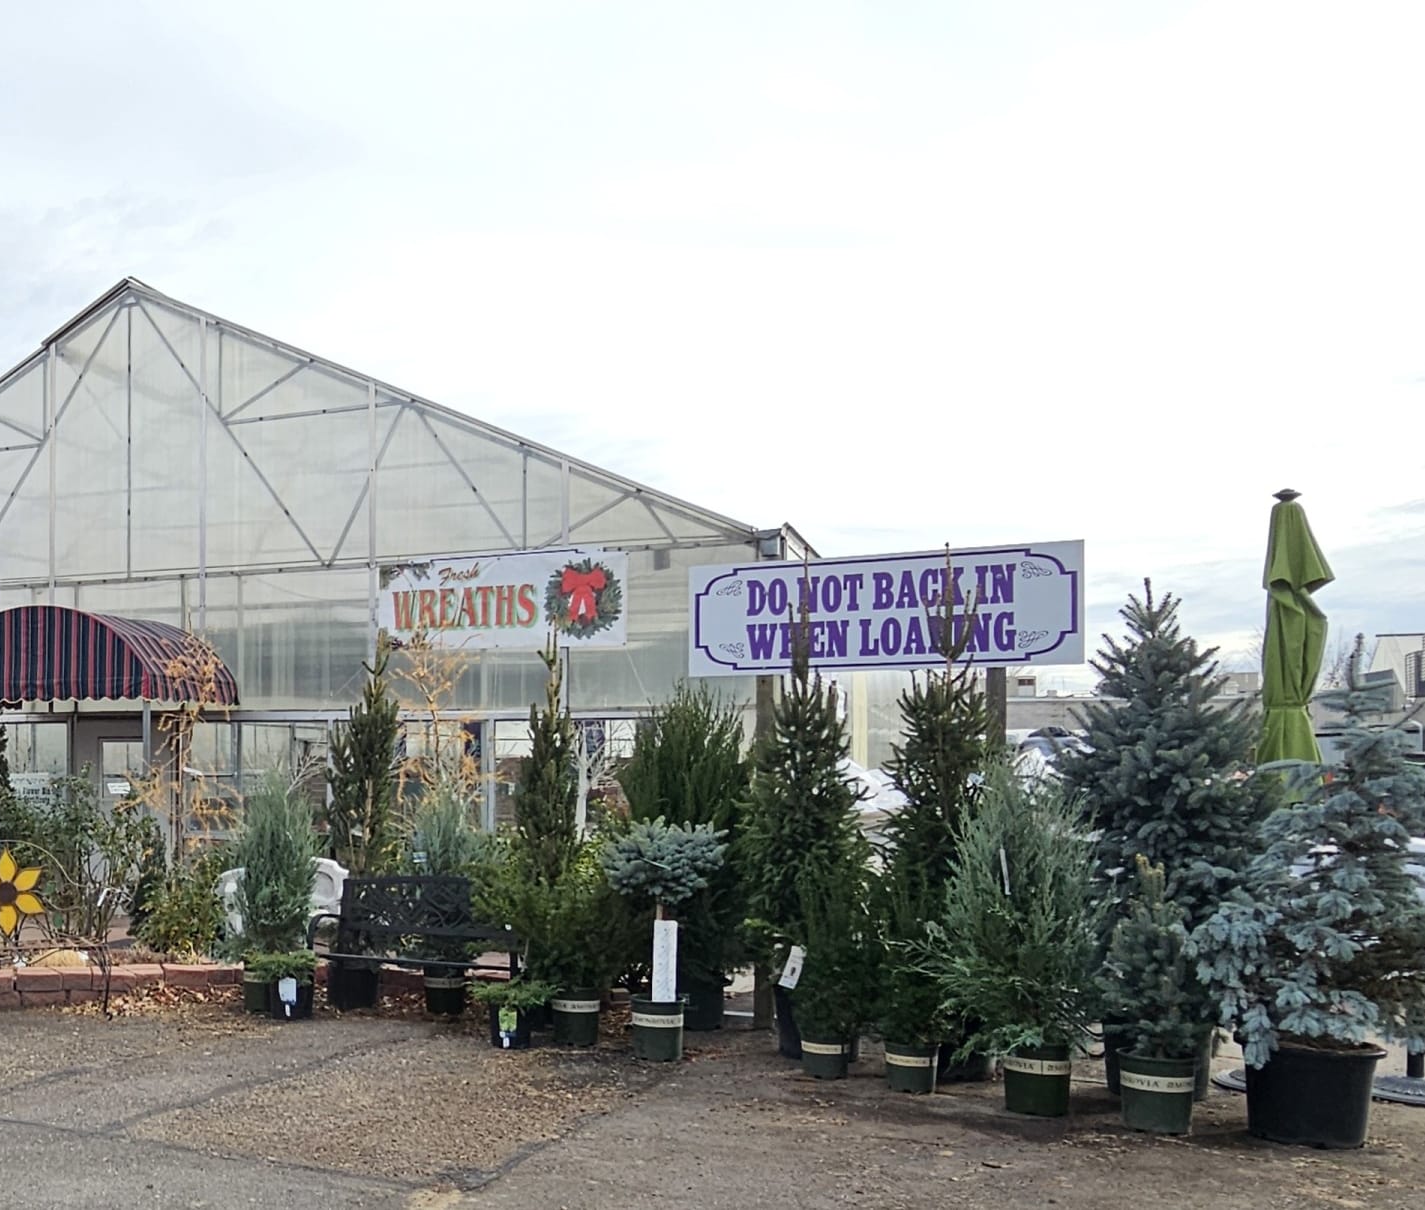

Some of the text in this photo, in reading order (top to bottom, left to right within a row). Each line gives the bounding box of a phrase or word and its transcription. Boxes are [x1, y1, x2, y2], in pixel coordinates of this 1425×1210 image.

[437, 561, 480, 586] Fresh
[746, 563, 1016, 617] DO NOT BACK IN
[392, 584, 536, 632] WREATHS
